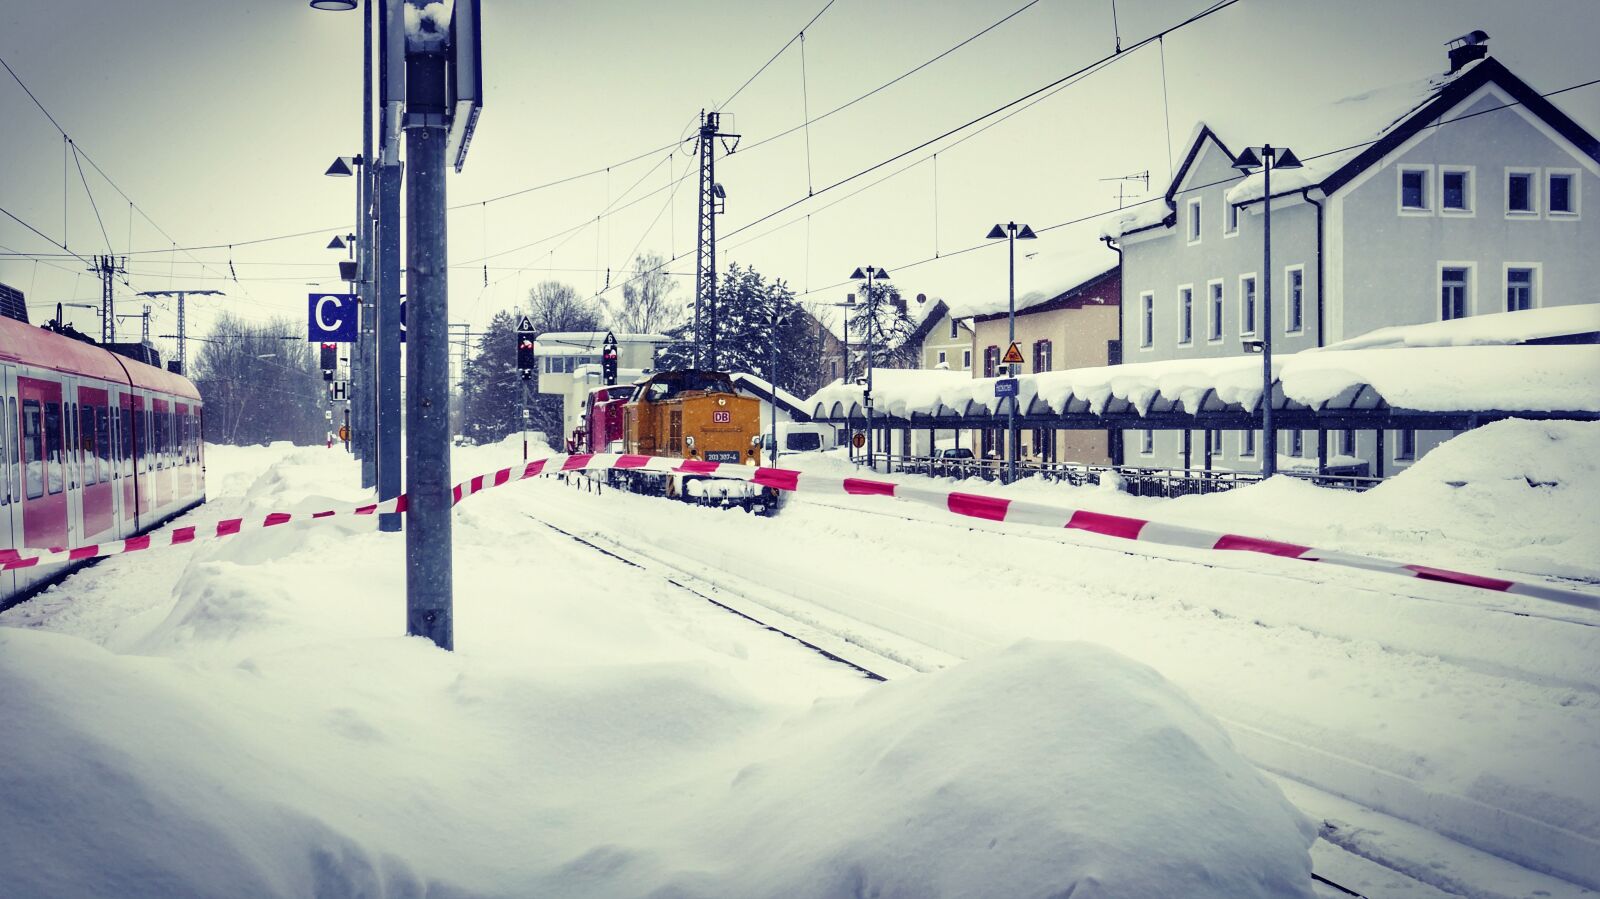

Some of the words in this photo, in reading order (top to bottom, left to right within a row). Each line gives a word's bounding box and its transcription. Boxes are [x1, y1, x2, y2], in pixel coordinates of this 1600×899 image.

[315, 295, 343, 332] C
[523, 320, 529, 330] 6
[607, 335, 613, 344] 6
[335, 382, 346, 399] H
[715, 412, 729, 423] DB
